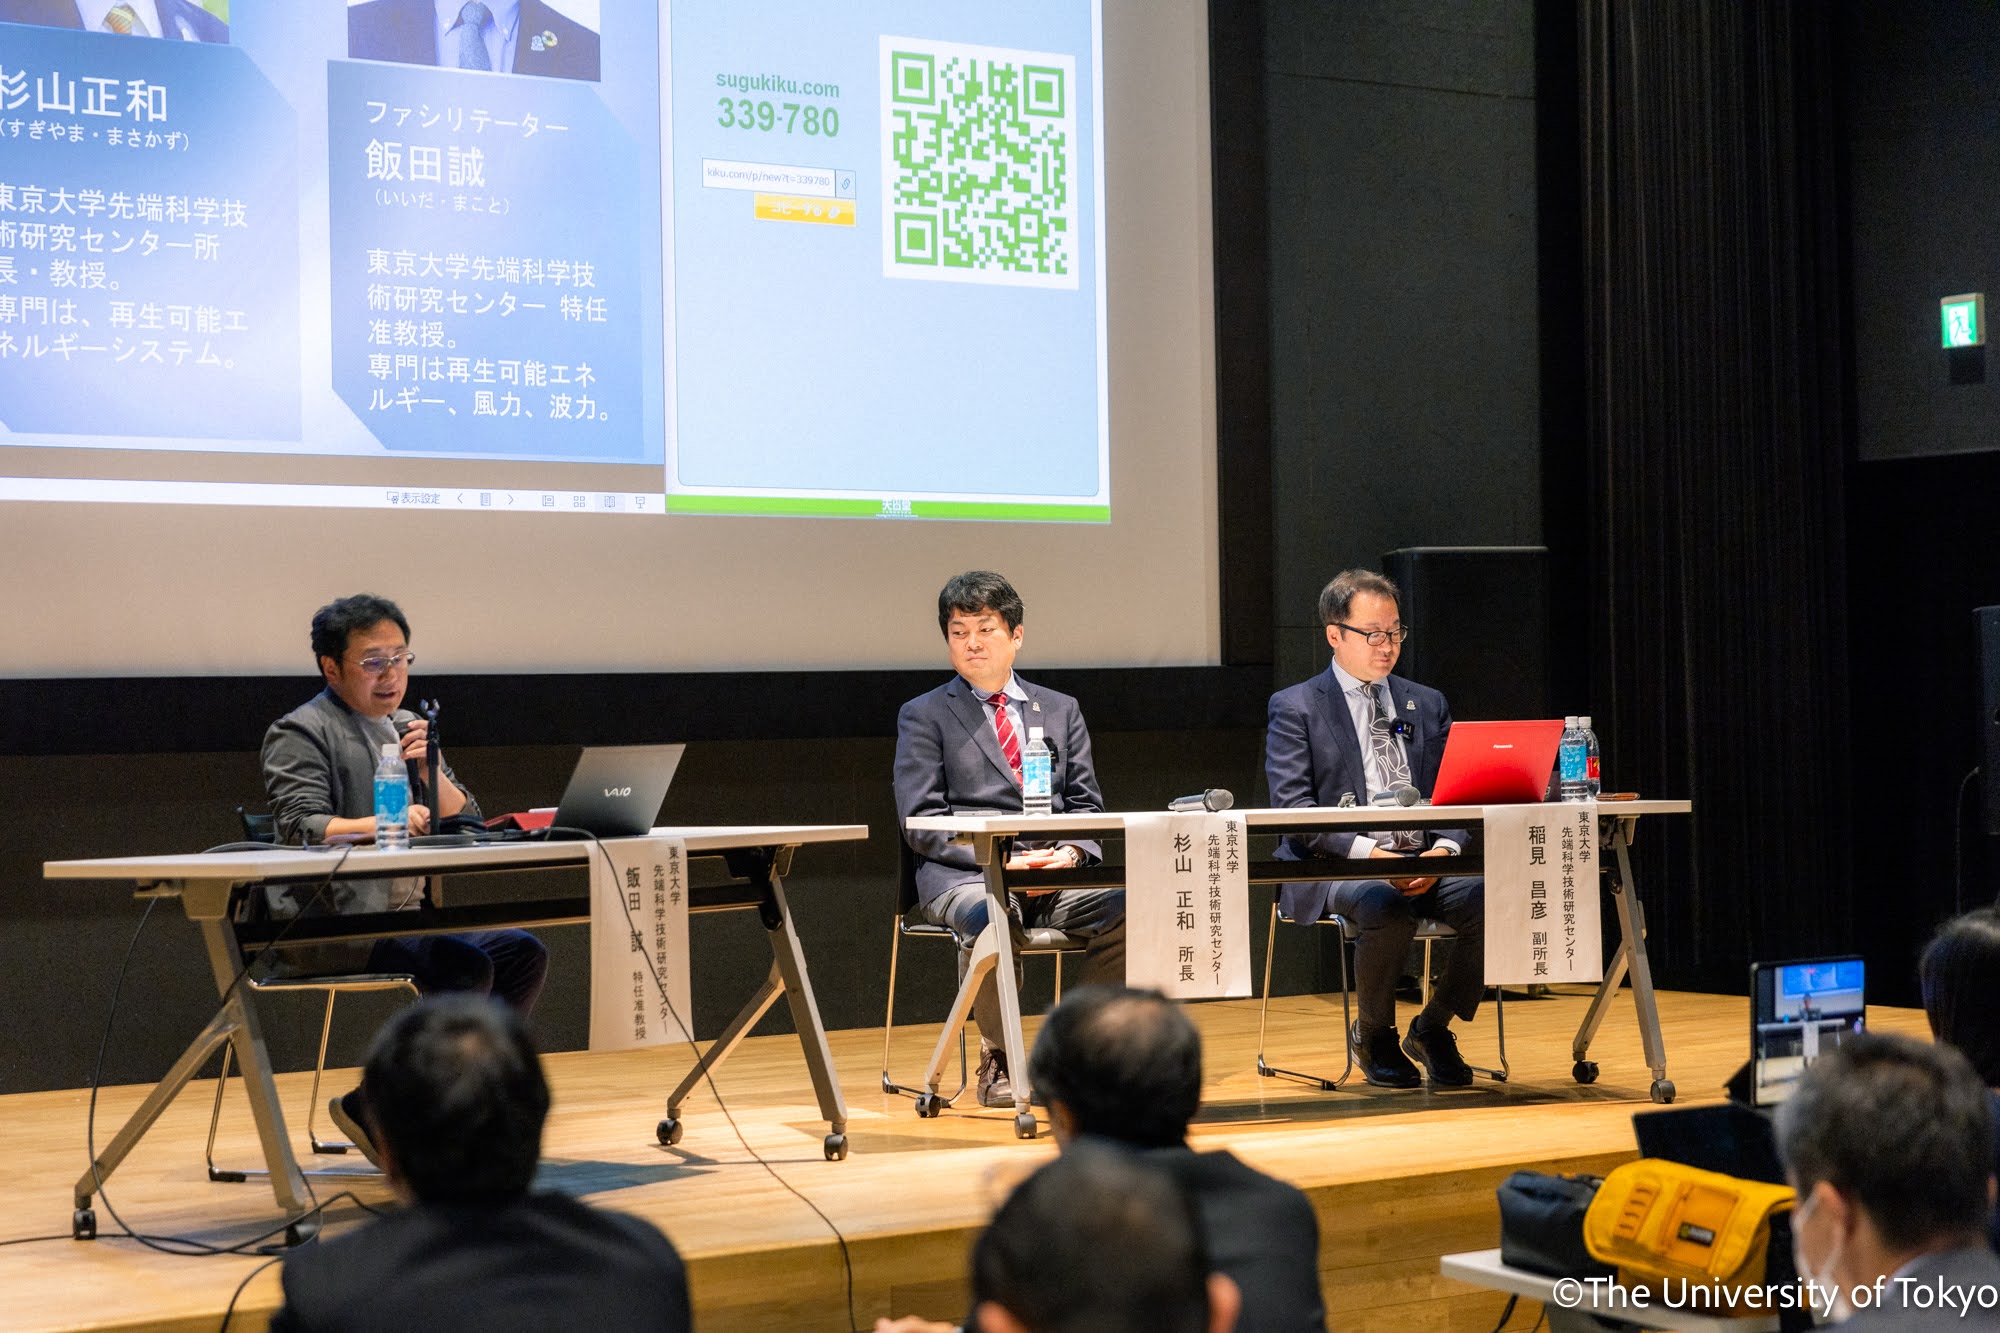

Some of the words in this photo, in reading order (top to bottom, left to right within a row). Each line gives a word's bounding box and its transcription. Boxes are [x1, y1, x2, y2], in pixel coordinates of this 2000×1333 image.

[0, 65, 168, 122] 杉山正和
[716, 72, 840, 98] sugukiku.com
[366, 101, 569, 138] ファシリテーター
[718, 97, 840, 137] 339-780
[365, 138, 486, 188] 飯田誠
[0, 183, 248, 228] 東京大学先端科学技
[0, 220, 220, 261] 術研究センター所
[0, 256, 120, 290] 長・教授。
[366, 247, 596, 289] 東京大学先端科学技
[0, 295, 249, 333] 専門は、再生可能エ
[367, 283, 546, 317] 術研究センター
[560, 294, 608, 322] 特任
[0, 332, 235, 369] ネルギーシステム。
[367, 318, 456, 349] 准教授。
[367, 353, 597, 388] 専門は再生可能エネ
[368, 385, 609, 422] ルギー、風力、波力。
[401, 491, 441, 505] 表示設定
[604, 786, 632, 797] VAIO
[1174, 833, 1192, 874] 杉山
[1225, 820, 1239, 874] 東京大学
[1528, 825, 1547, 866] 稲見
[1578, 811, 1591, 863] 東京大学
[625, 866, 641, 912] 飯田
[667, 846, 682, 906] 東京大学
[1176, 890, 1195, 931] 正和
[1207, 833, 1223, 985] 先端科学技術研究センター
[1530, 880, 1548, 920] 昌彦
[1561, 826, 1576, 972] 先端科学技術研究センター
[1178, 945, 1195, 982] 所長
[1532, 931, 1549, 976] 副所長
[632, 971, 648, 1041] 特任准教授
